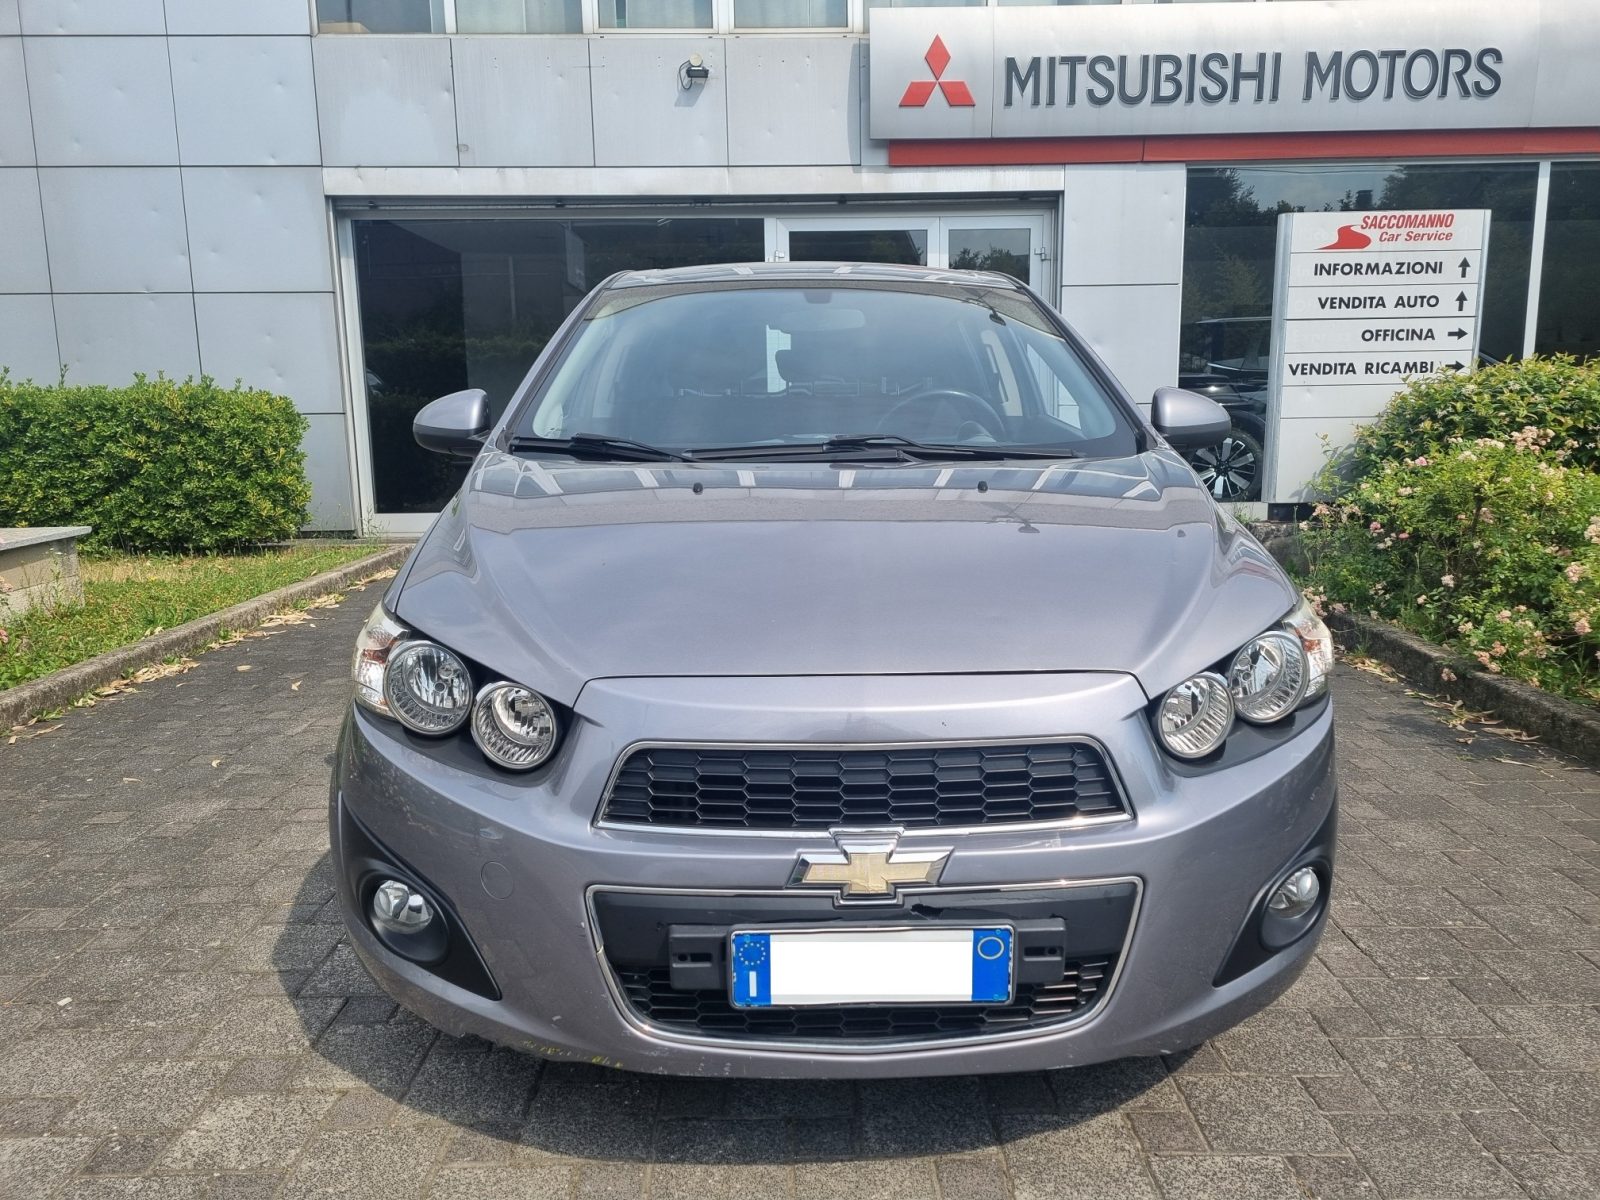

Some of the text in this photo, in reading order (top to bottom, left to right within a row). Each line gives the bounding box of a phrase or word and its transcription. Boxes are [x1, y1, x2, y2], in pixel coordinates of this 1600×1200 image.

[1003, 47, 1503, 106] MITSUBISHI MOTORS
[1360, 213, 1455, 230] SACCOMANNO
[1379, 230, 1453, 242] Car Service
[1313, 261, 1443, 276] INFORMAZIONI
[1317, 295, 1439, 309] VENDITA AUTO
[1361, 328, 1435, 341] OFFICINA
[1288, 361, 1434, 376] VENDITA RICAMBI
